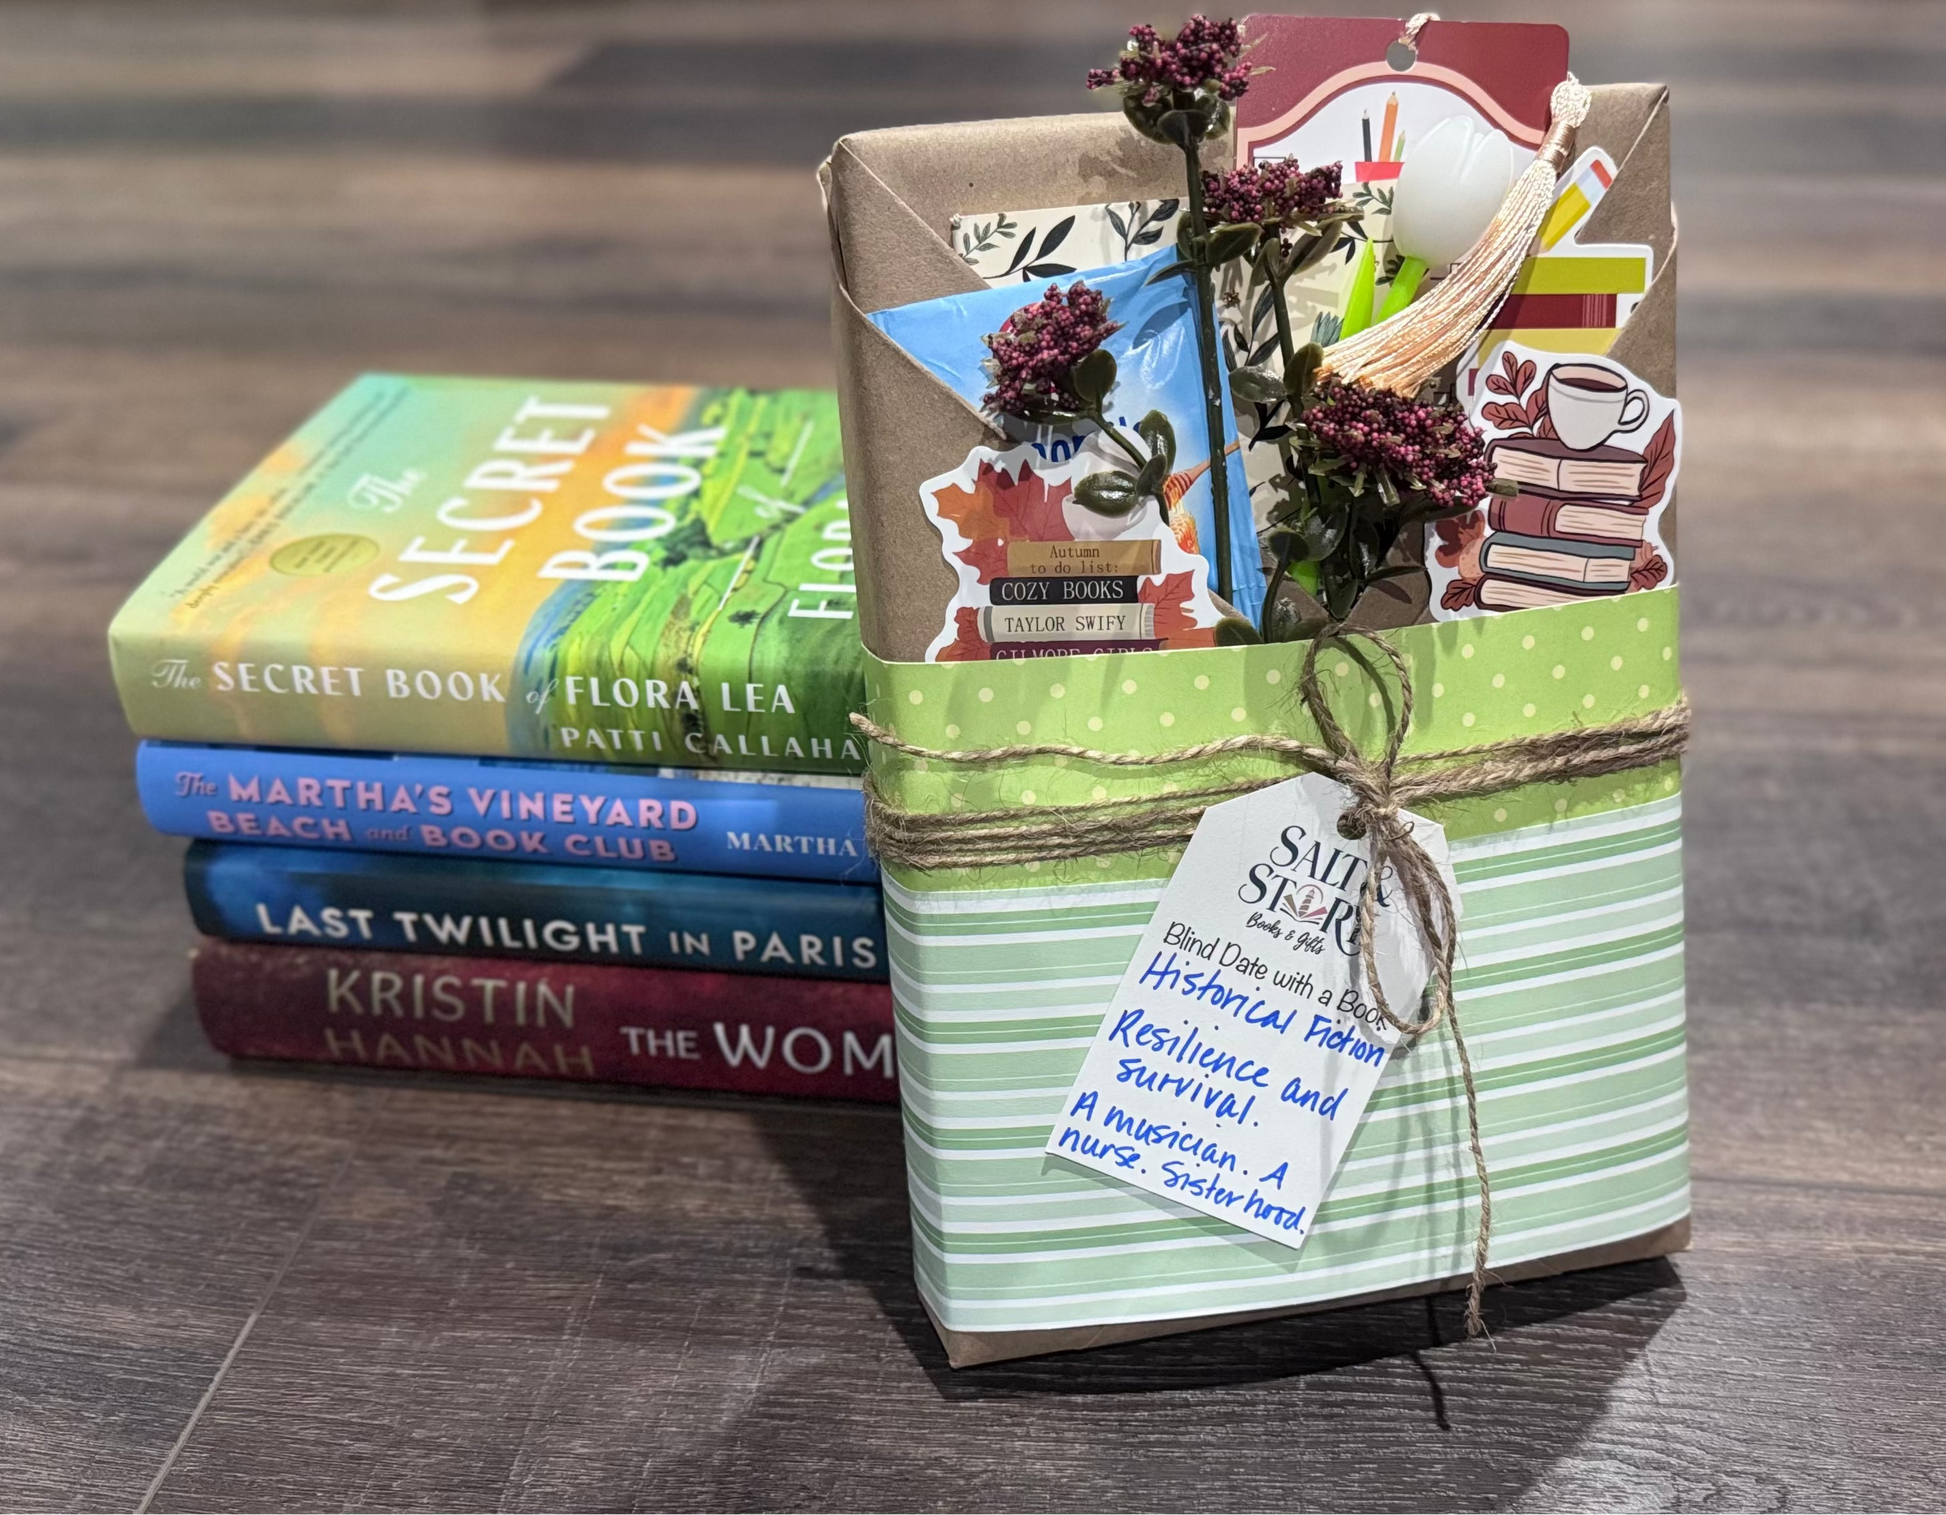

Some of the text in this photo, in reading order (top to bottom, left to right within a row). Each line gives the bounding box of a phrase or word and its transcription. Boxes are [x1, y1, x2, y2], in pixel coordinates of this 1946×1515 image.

[368, 396, 611, 605] SECRET
[537, 423, 727, 582] BOOK
[1030, 560, 1119, 575] to do list:
[1049, 544, 1101, 559] Autumn
[1001, 580, 1124, 601] COZY BOOKS
[1004, 615, 1127, 633] TAYLOR SWIFY
[151, 658, 797, 715] The SECRET BOOK of FLORA LEA
[560, 726, 662, 752] PATTI
[174, 771, 699, 832] The MARTHA'S VINEYARD
[206, 810, 677, 863] BEACH and BOOK CLUB
[727, 831, 859, 857] MARTHA
[1269, 825, 1369, 892] SALT
[256, 903, 877, 969] LAST TWILIGHT IN PARIS
[1245, 911, 1326, 955] Books & Gifts
[1163, 921, 1221, 961] Blind
[1218, 942, 1269, 980] Date
[1272, 971, 1315, 999] with
[1318, 989, 1333, 1007] a
[328, 967, 575, 1029] KRISTIN
[1139, 951, 1386, 1068] Historical Fiction
[323, 1027, 595, 1077] HANNAH
[619, 1020, 894, 1079] THE WOM
[1108, 1008, 1349, 1121] Resilience and
[1058, 1126, 1147, 1175] nurse.
[1070, 1090, 1289, 1190] A musician. A
